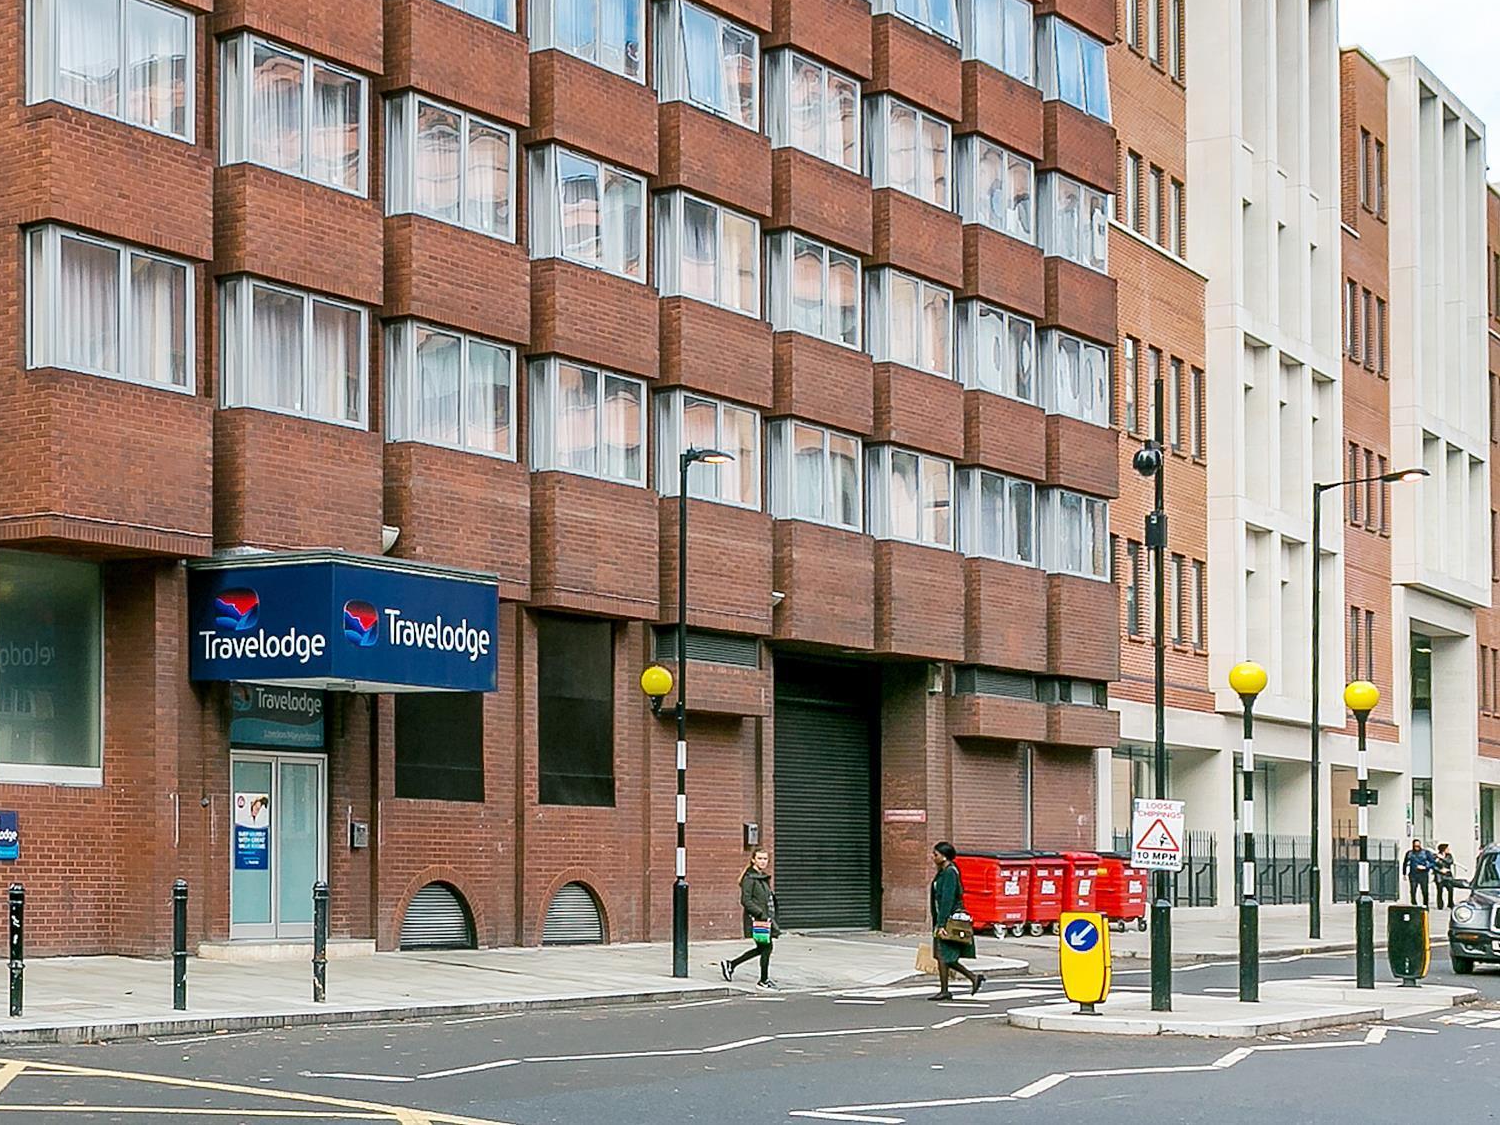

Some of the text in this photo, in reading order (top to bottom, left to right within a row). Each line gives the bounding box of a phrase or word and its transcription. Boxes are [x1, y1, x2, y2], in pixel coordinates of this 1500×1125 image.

[199, 627, 326, 664] Travelodge
[384, 608, 490, 661] Travelodge
[256, 687, 322, 717] Travelodge
[1146, 802, 1173, 810] LOOSE
[1137, 851, 1177, 861] 10 MPH
